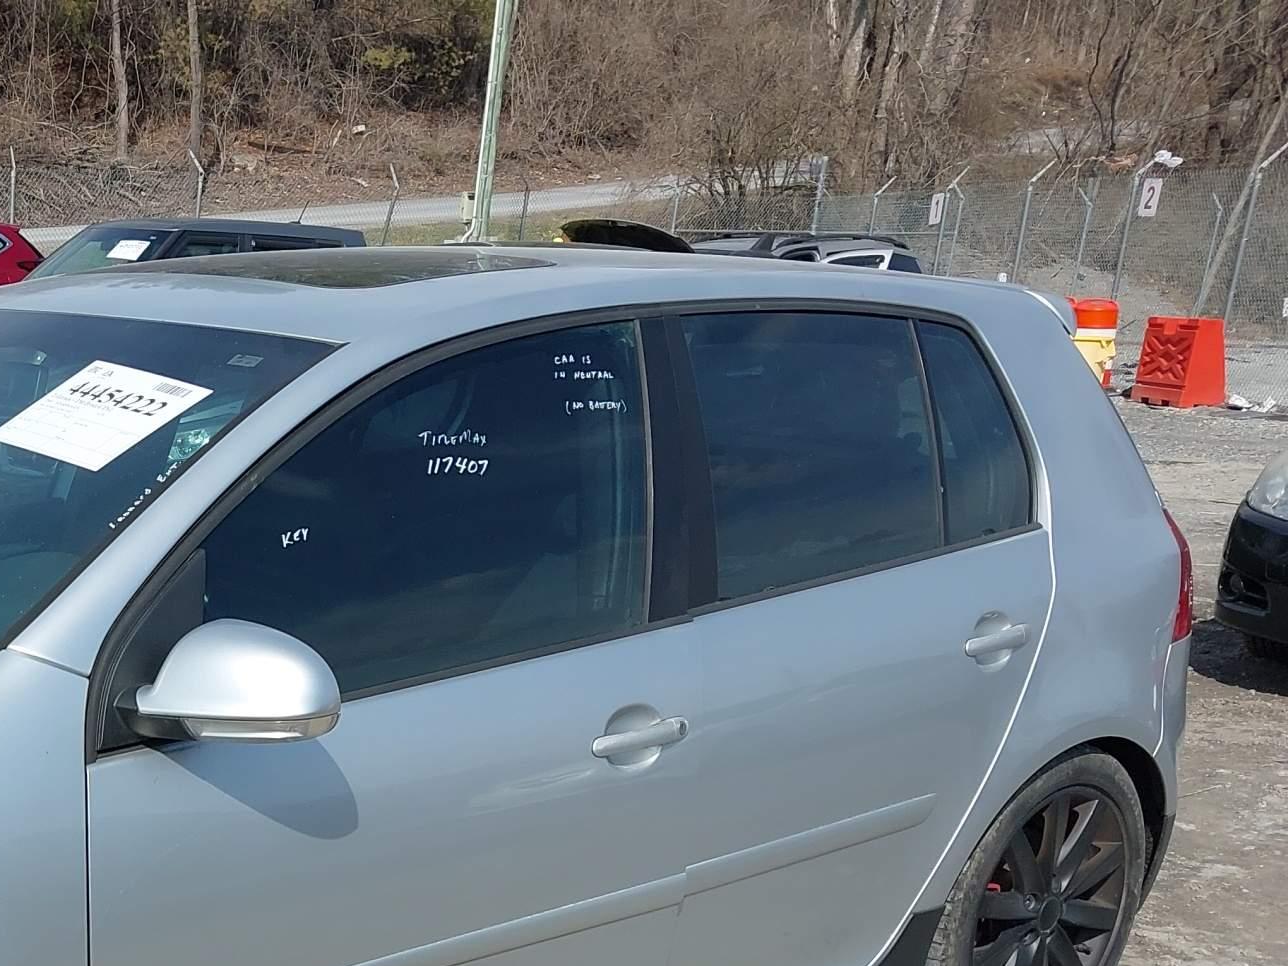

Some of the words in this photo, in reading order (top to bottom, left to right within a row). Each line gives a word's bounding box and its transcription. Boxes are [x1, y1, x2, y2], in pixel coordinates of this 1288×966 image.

[1144, 186, 1156, 209] 2
[582, 355, 592, 364] IS
[554, 371, 566, 379] IN
[574, 370, 614, 380] NEUTRAL
[69, 381, 168, 416] 44454222
[427, 457, 489, 475] 117407
[282, 528, 309, 548] KEY
